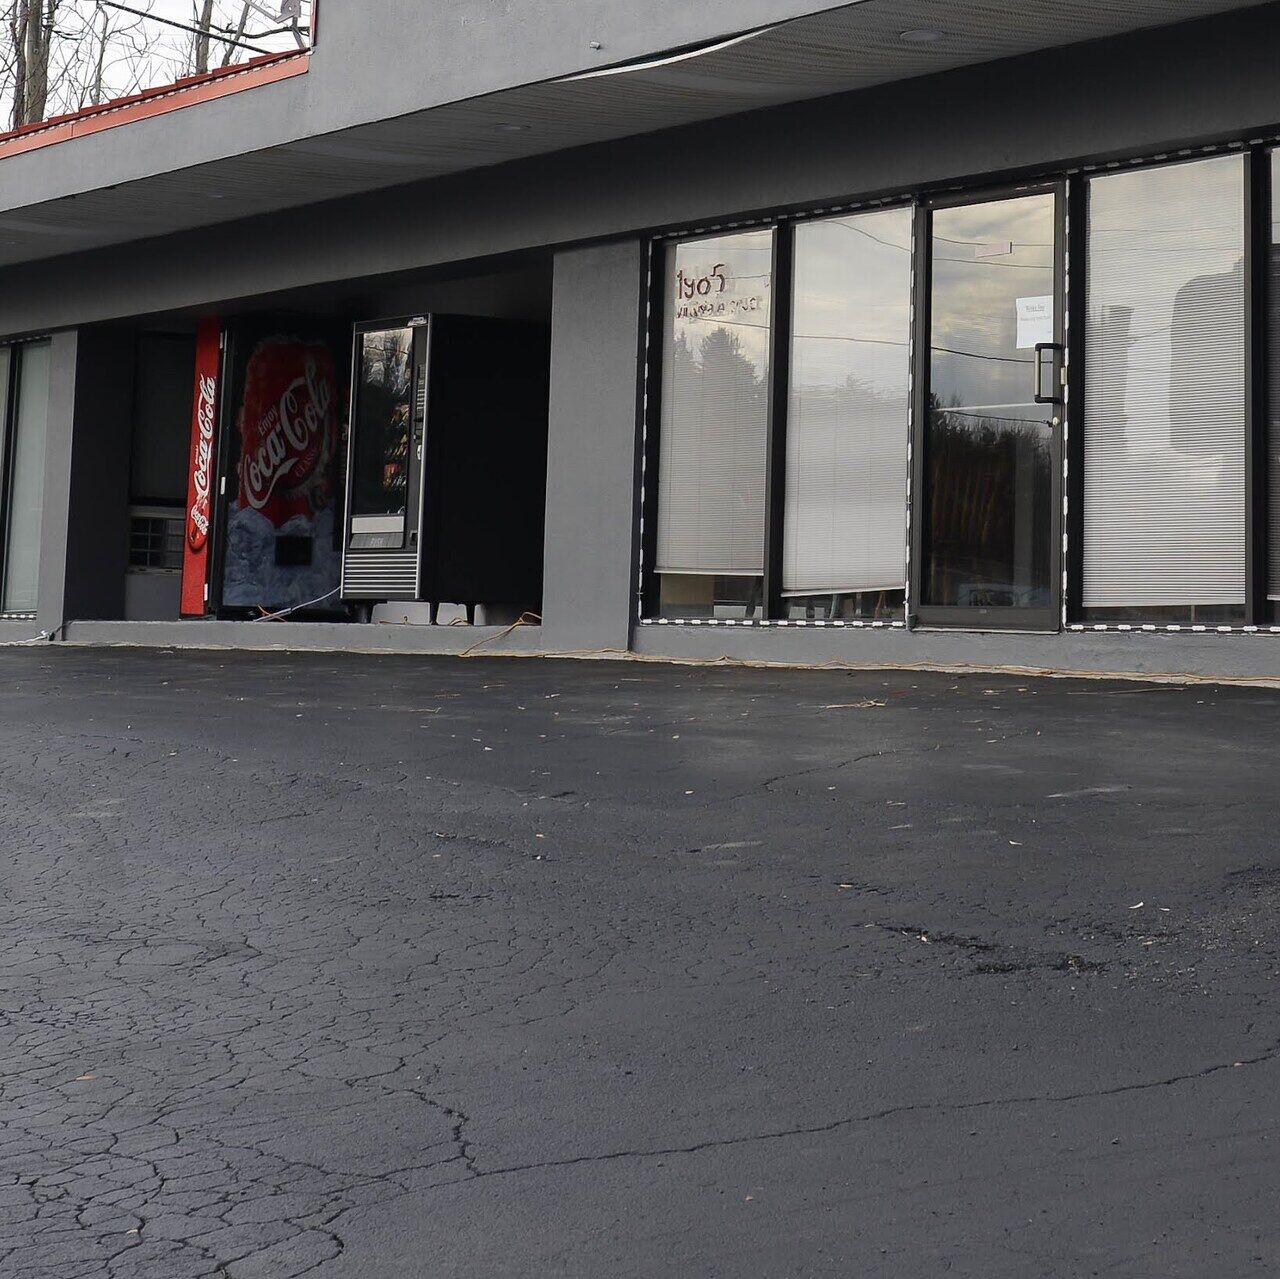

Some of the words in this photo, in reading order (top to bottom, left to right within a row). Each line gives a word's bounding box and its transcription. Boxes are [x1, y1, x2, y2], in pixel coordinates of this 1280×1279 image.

[194, 373, 216, 498] Coca-Cola
[243, 359, 331, 509] Coca-Cola
[258, 404, 279, 435] Enjoy
